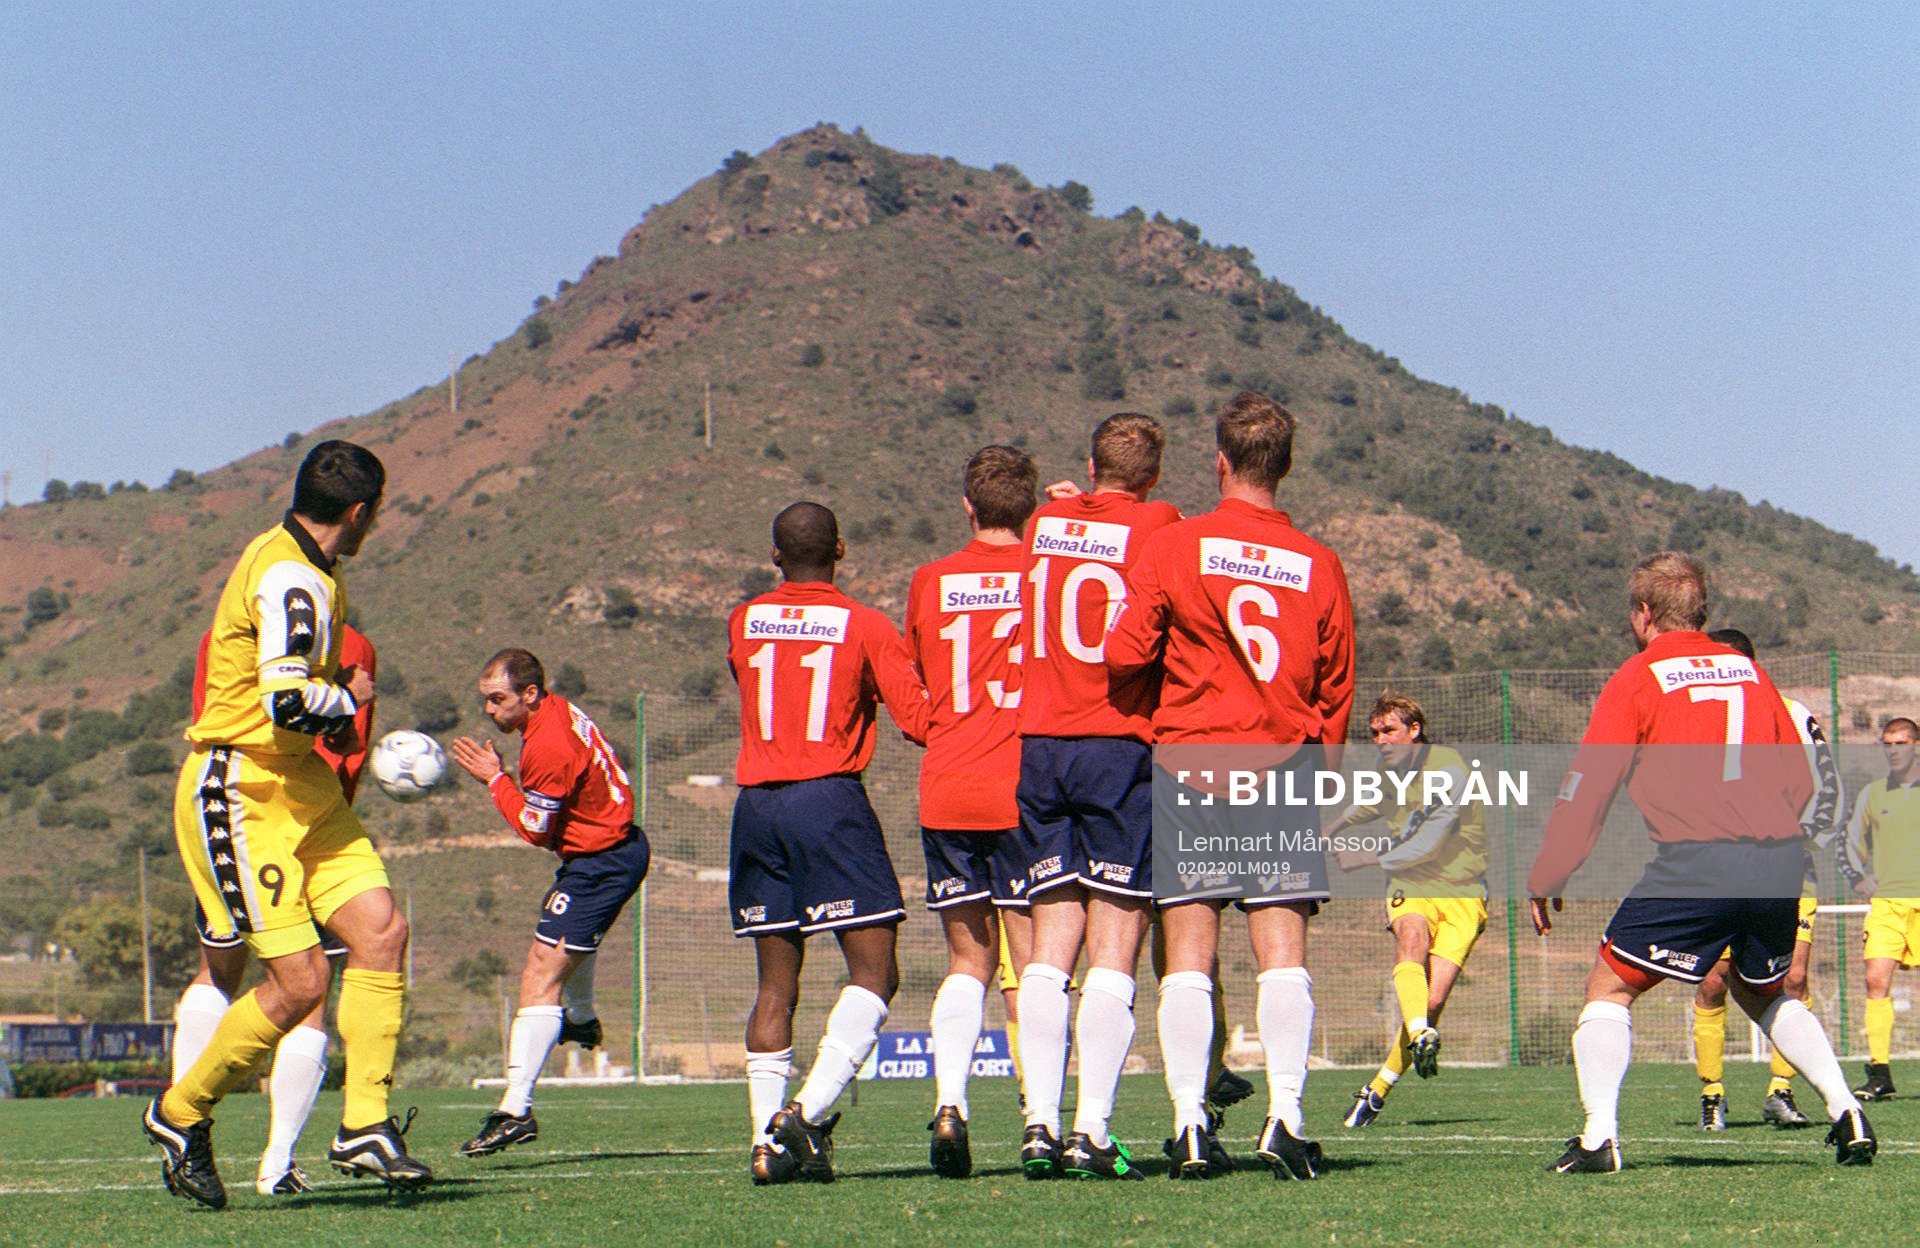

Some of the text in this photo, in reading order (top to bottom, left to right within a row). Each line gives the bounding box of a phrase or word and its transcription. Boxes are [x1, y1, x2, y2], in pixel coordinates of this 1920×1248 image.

[1028, 557, 1127, 664] 10
[1227, 584, 1281, 684] 6
[747, 642, 835, 742] 11
[1687, 684, 1746, 783] 7
[1102, 862, 1134, 876] INTER
[257, 863, 285, 907] 9
[825, 900, 855, 912] INTER
[1668, 949, 1700, 964] INTER
[895, 1037, 922, 1054] LA
[879, 1059, 928, 1078] CLUB
